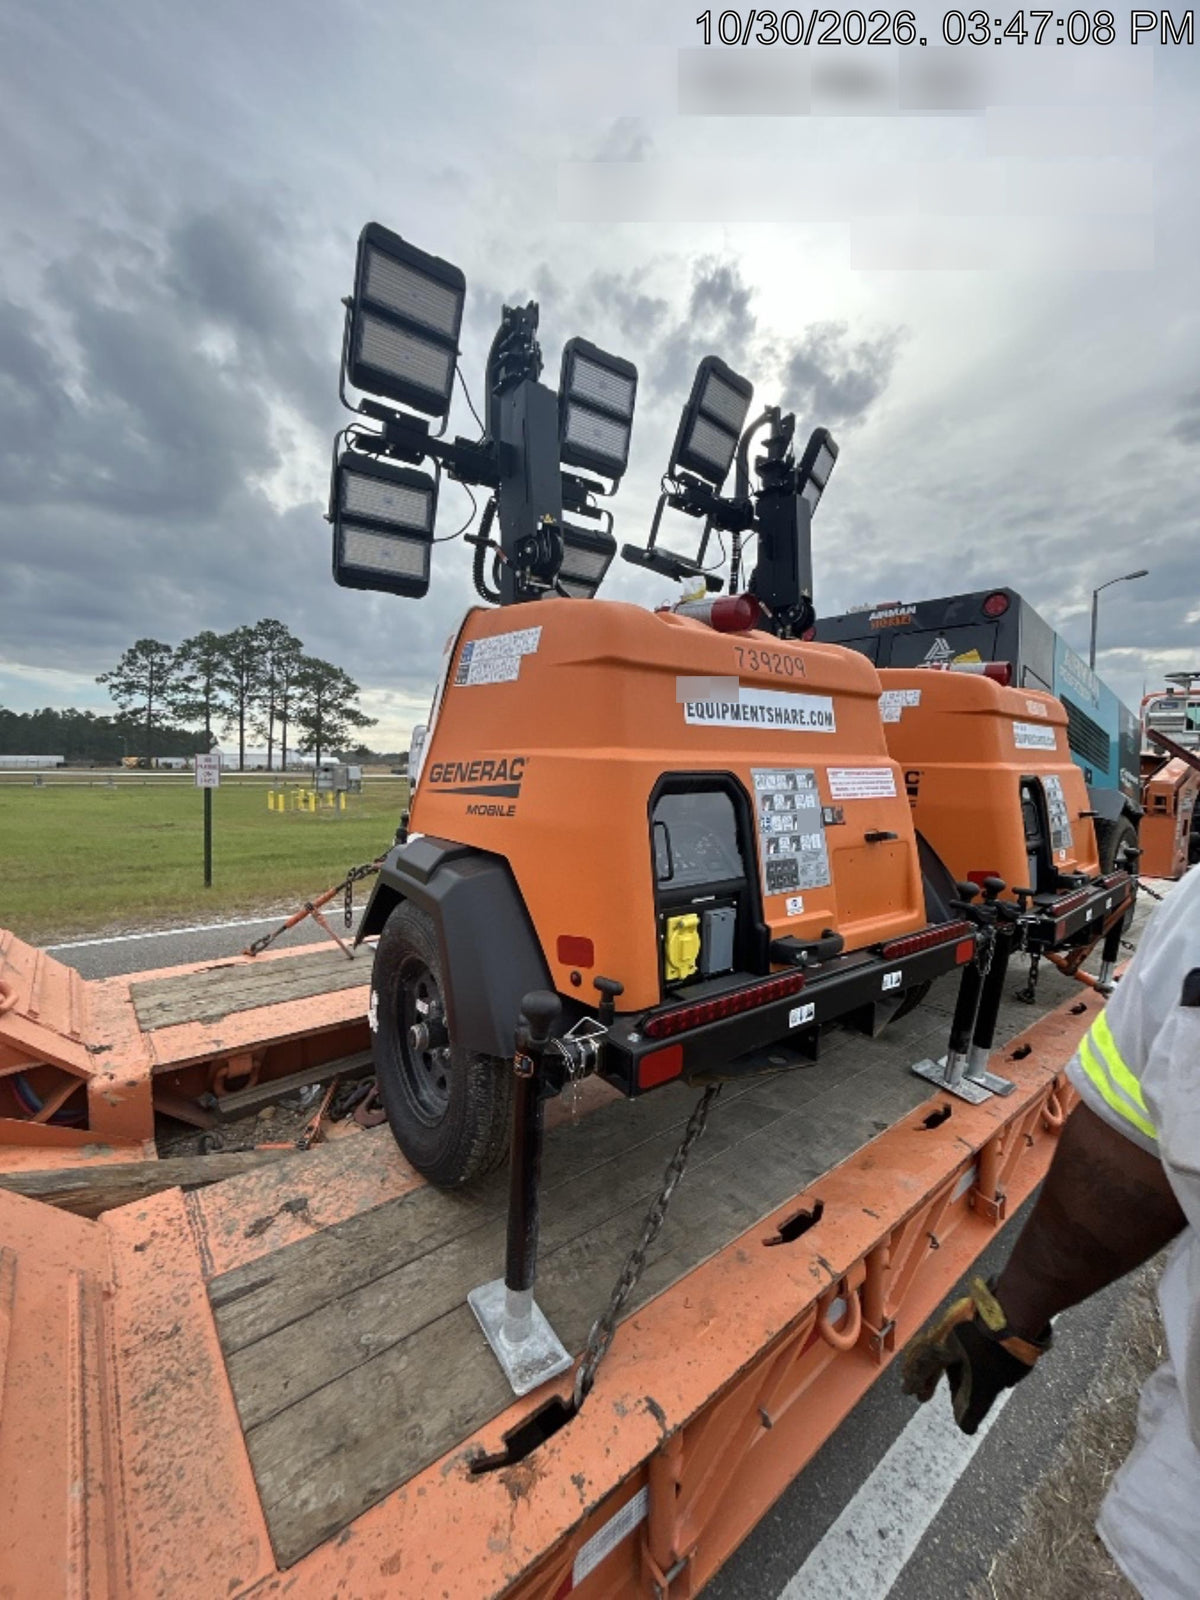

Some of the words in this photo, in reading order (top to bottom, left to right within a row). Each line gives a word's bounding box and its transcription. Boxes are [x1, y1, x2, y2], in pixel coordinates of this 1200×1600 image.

[734, 646, 806, 677] 739209
[687, 702, 833, 727] EQUIPMENTSHARE.COM
[429, 757, 525, 783] GENERAC
[465, 804, 517, 817] MOBILE
